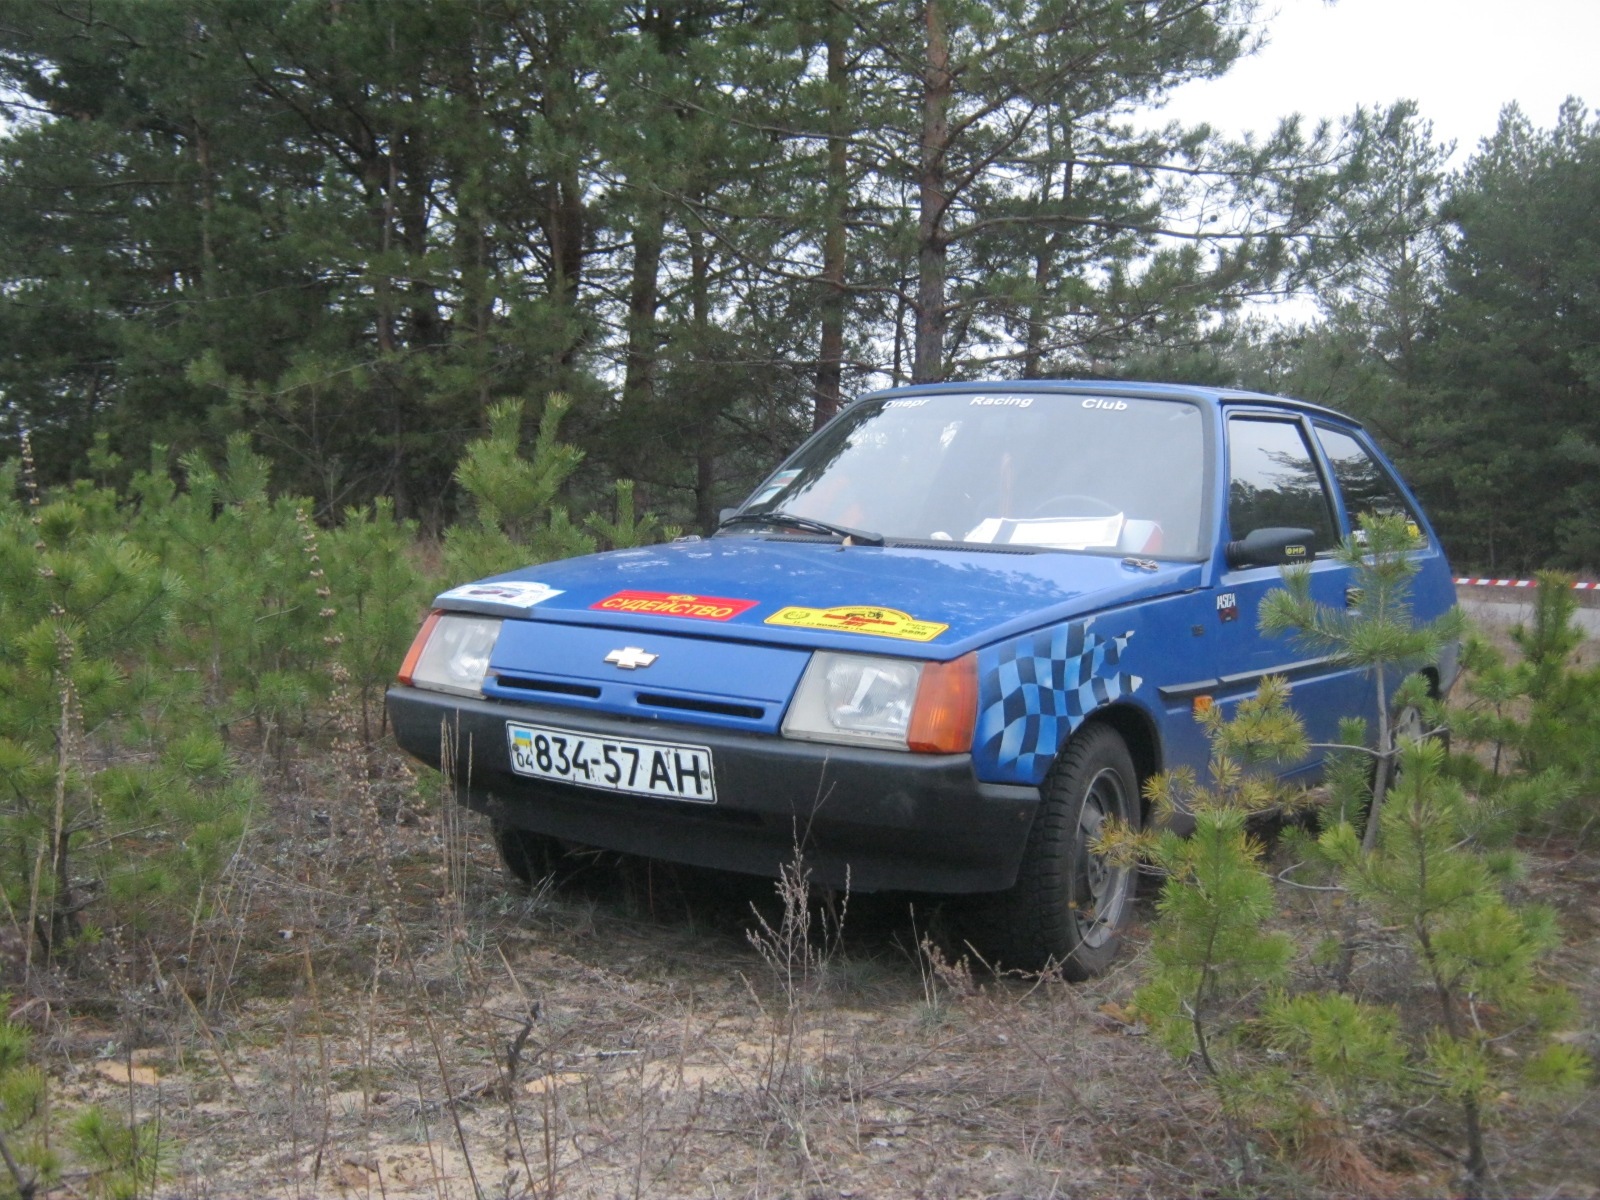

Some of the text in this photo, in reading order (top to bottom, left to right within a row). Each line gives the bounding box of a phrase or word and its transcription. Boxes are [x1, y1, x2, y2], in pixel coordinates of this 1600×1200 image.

[881, 396, 1128, 411] Dnepr Racing Club
[601, 597, 733, 618] СУДЕЙСТВО
[516, 752, 534, 770] 04
